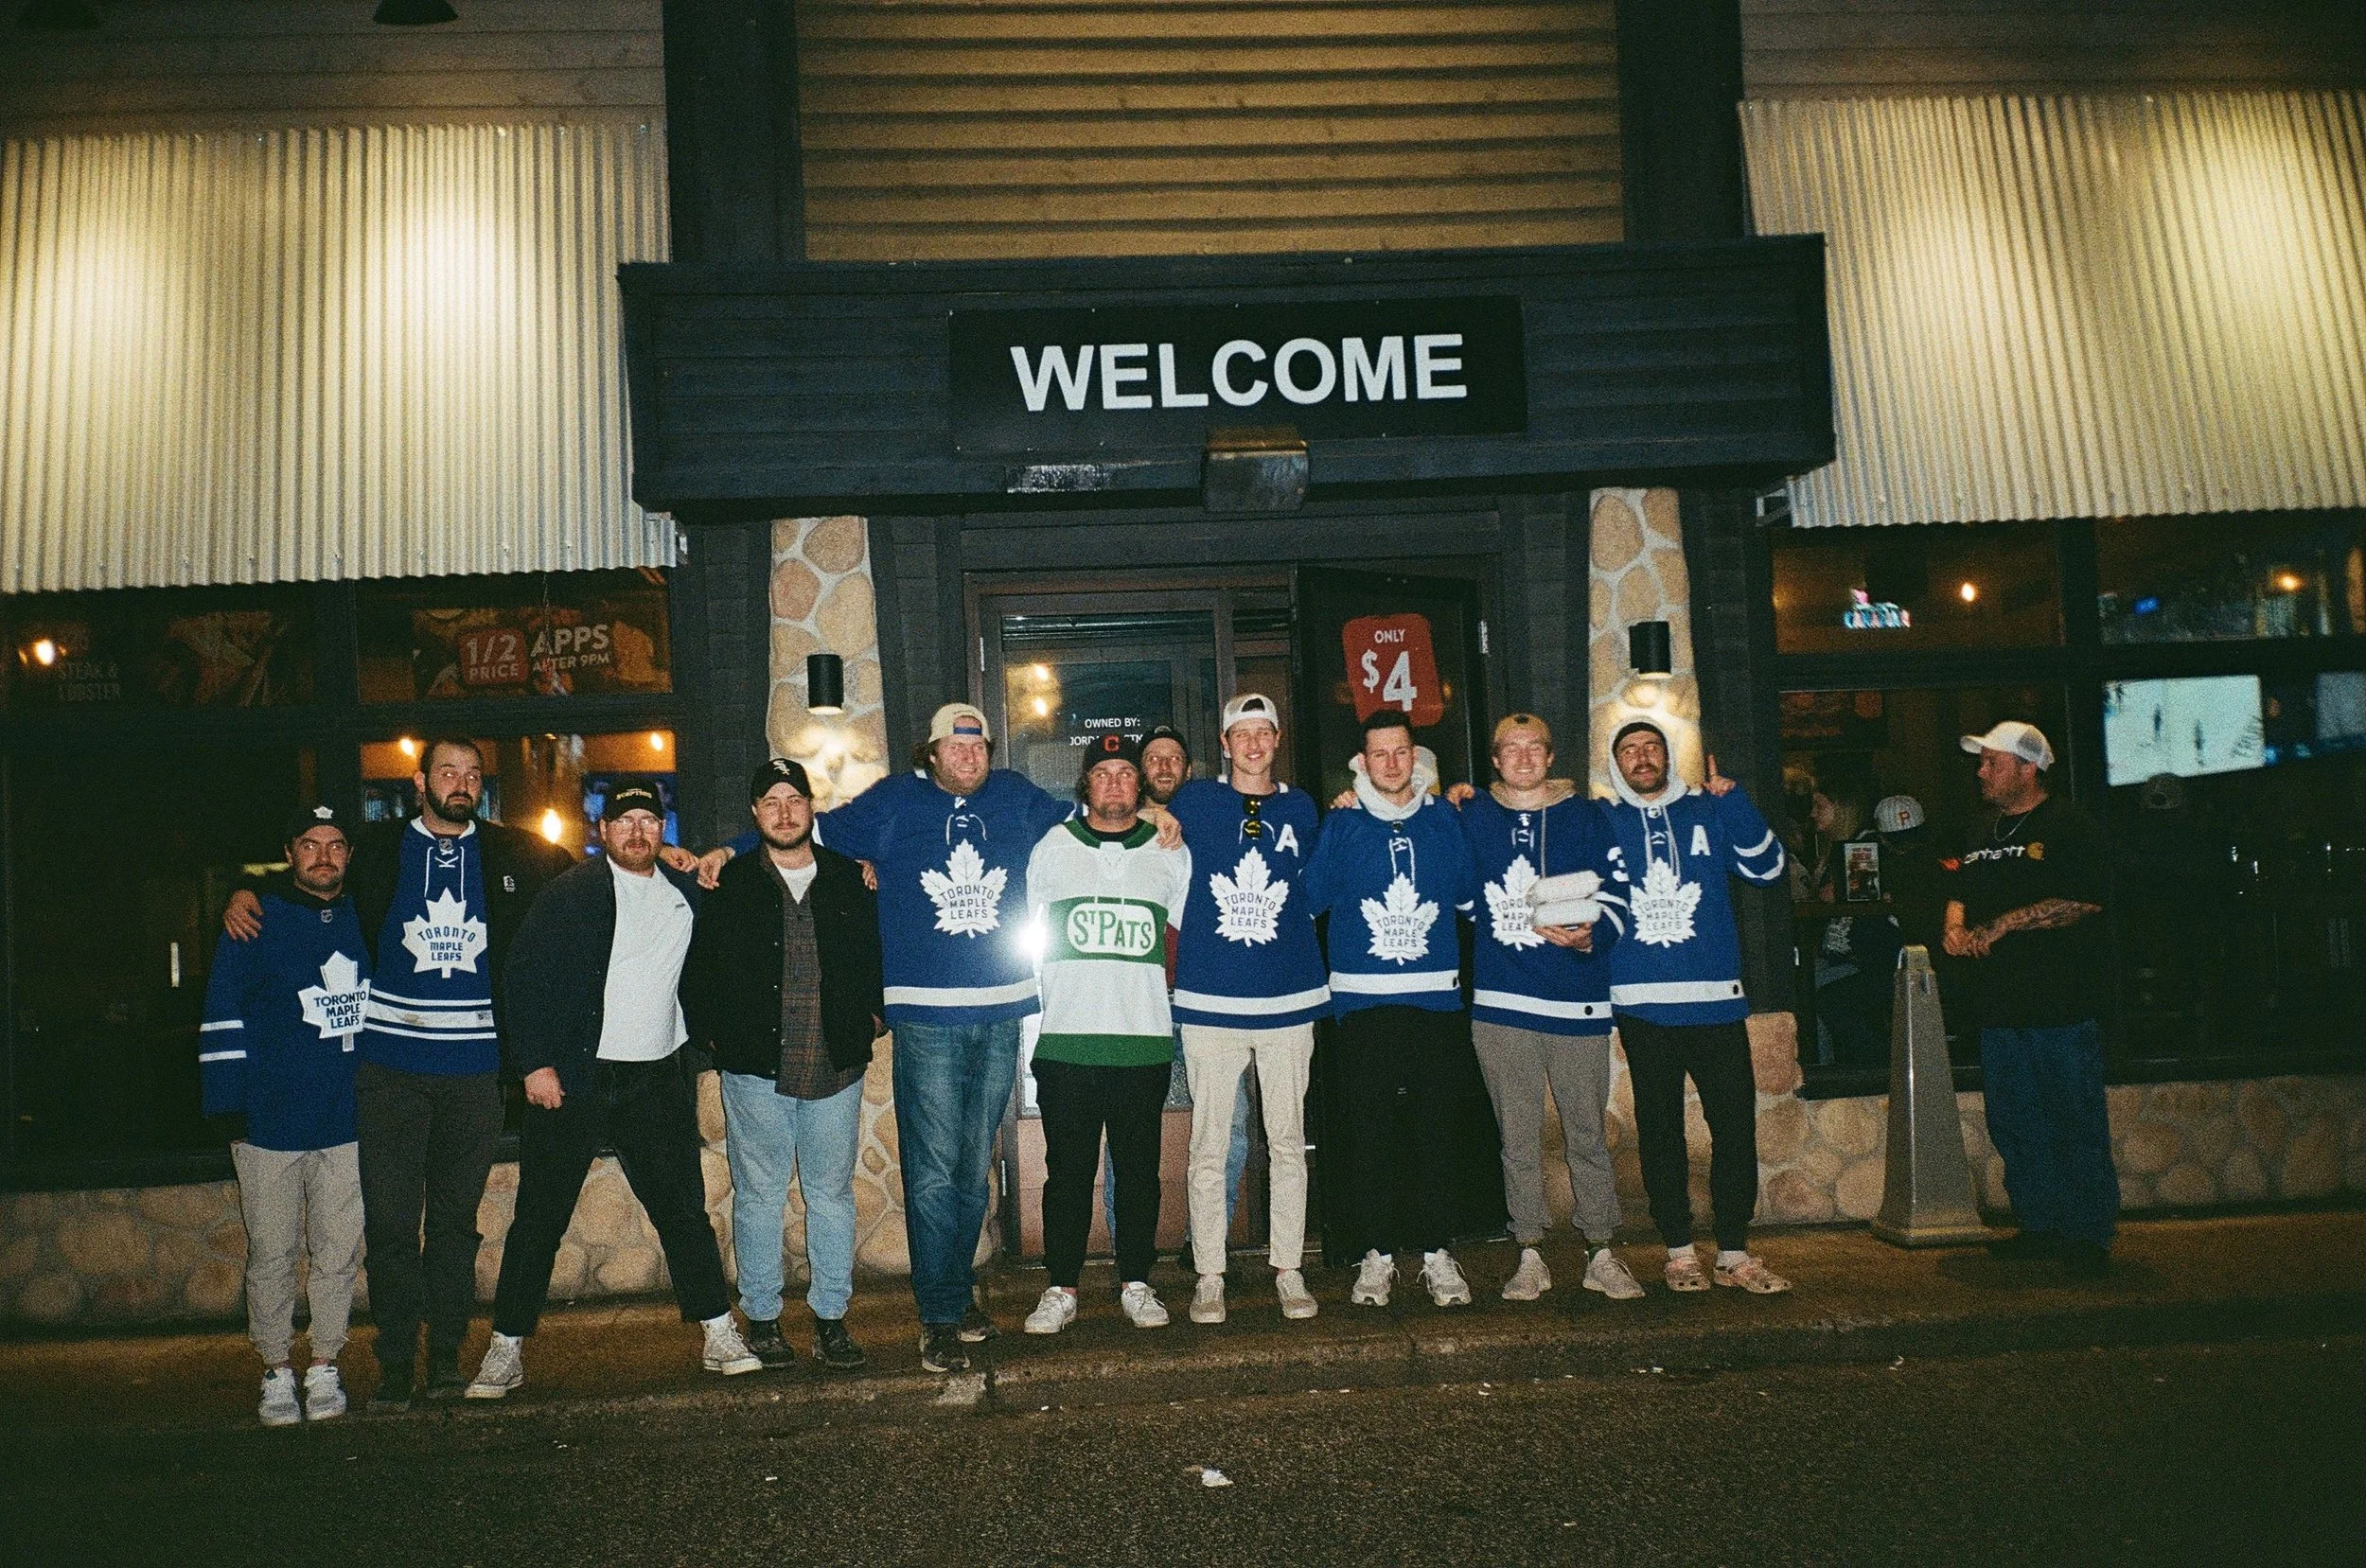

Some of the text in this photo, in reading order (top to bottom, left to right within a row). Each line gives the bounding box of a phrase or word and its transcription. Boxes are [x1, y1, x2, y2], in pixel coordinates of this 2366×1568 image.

[1010, 333, 1468, 412] WELCOME
[530, 624, 609, 657] APPS
[1374, 628, 1405, 643] ONLY
[466, 634, 518, 665] 1/2
[580, 653, 610, 667] 9PM
[468, 663, 520, 680] PRICE
[1361, 648, 1418, 712] $4
[1085, 717, 1140, 729] OWNED BY:
[1103, 734, 1121, 752] C
[1275, 823, 1298, 857] A
[1690, 824, 1711, 855] A
[940, 885, 994, 901] TORONTO
[949, 898, 987, 907] MAPLE
[1224, 892, 1276, 910] TORONTO
[950, 909, 987, 920] LEAFS
[1231, 906, 1267, 918] MAPLE
[1230, 917, 1267, 928] LEAFS
[1376, 915, 1425, 930] TORONTO
[1501, 922, 1529, 931] LEAF
[417, 925, 476, 943] TORONTO
[1384, 928, 1418, 938] MAPLE
[430, 942, 463, 951] MAPLE
[1384, 938, 1418, 947] LEAFS
[432, 952, 462, 961] LEAFS
[314, 991, 366, 1007] TORONTO
[326, 1003, 361, 1018] MAPLE
[330, 1014, 360, 1029] LEAFS
